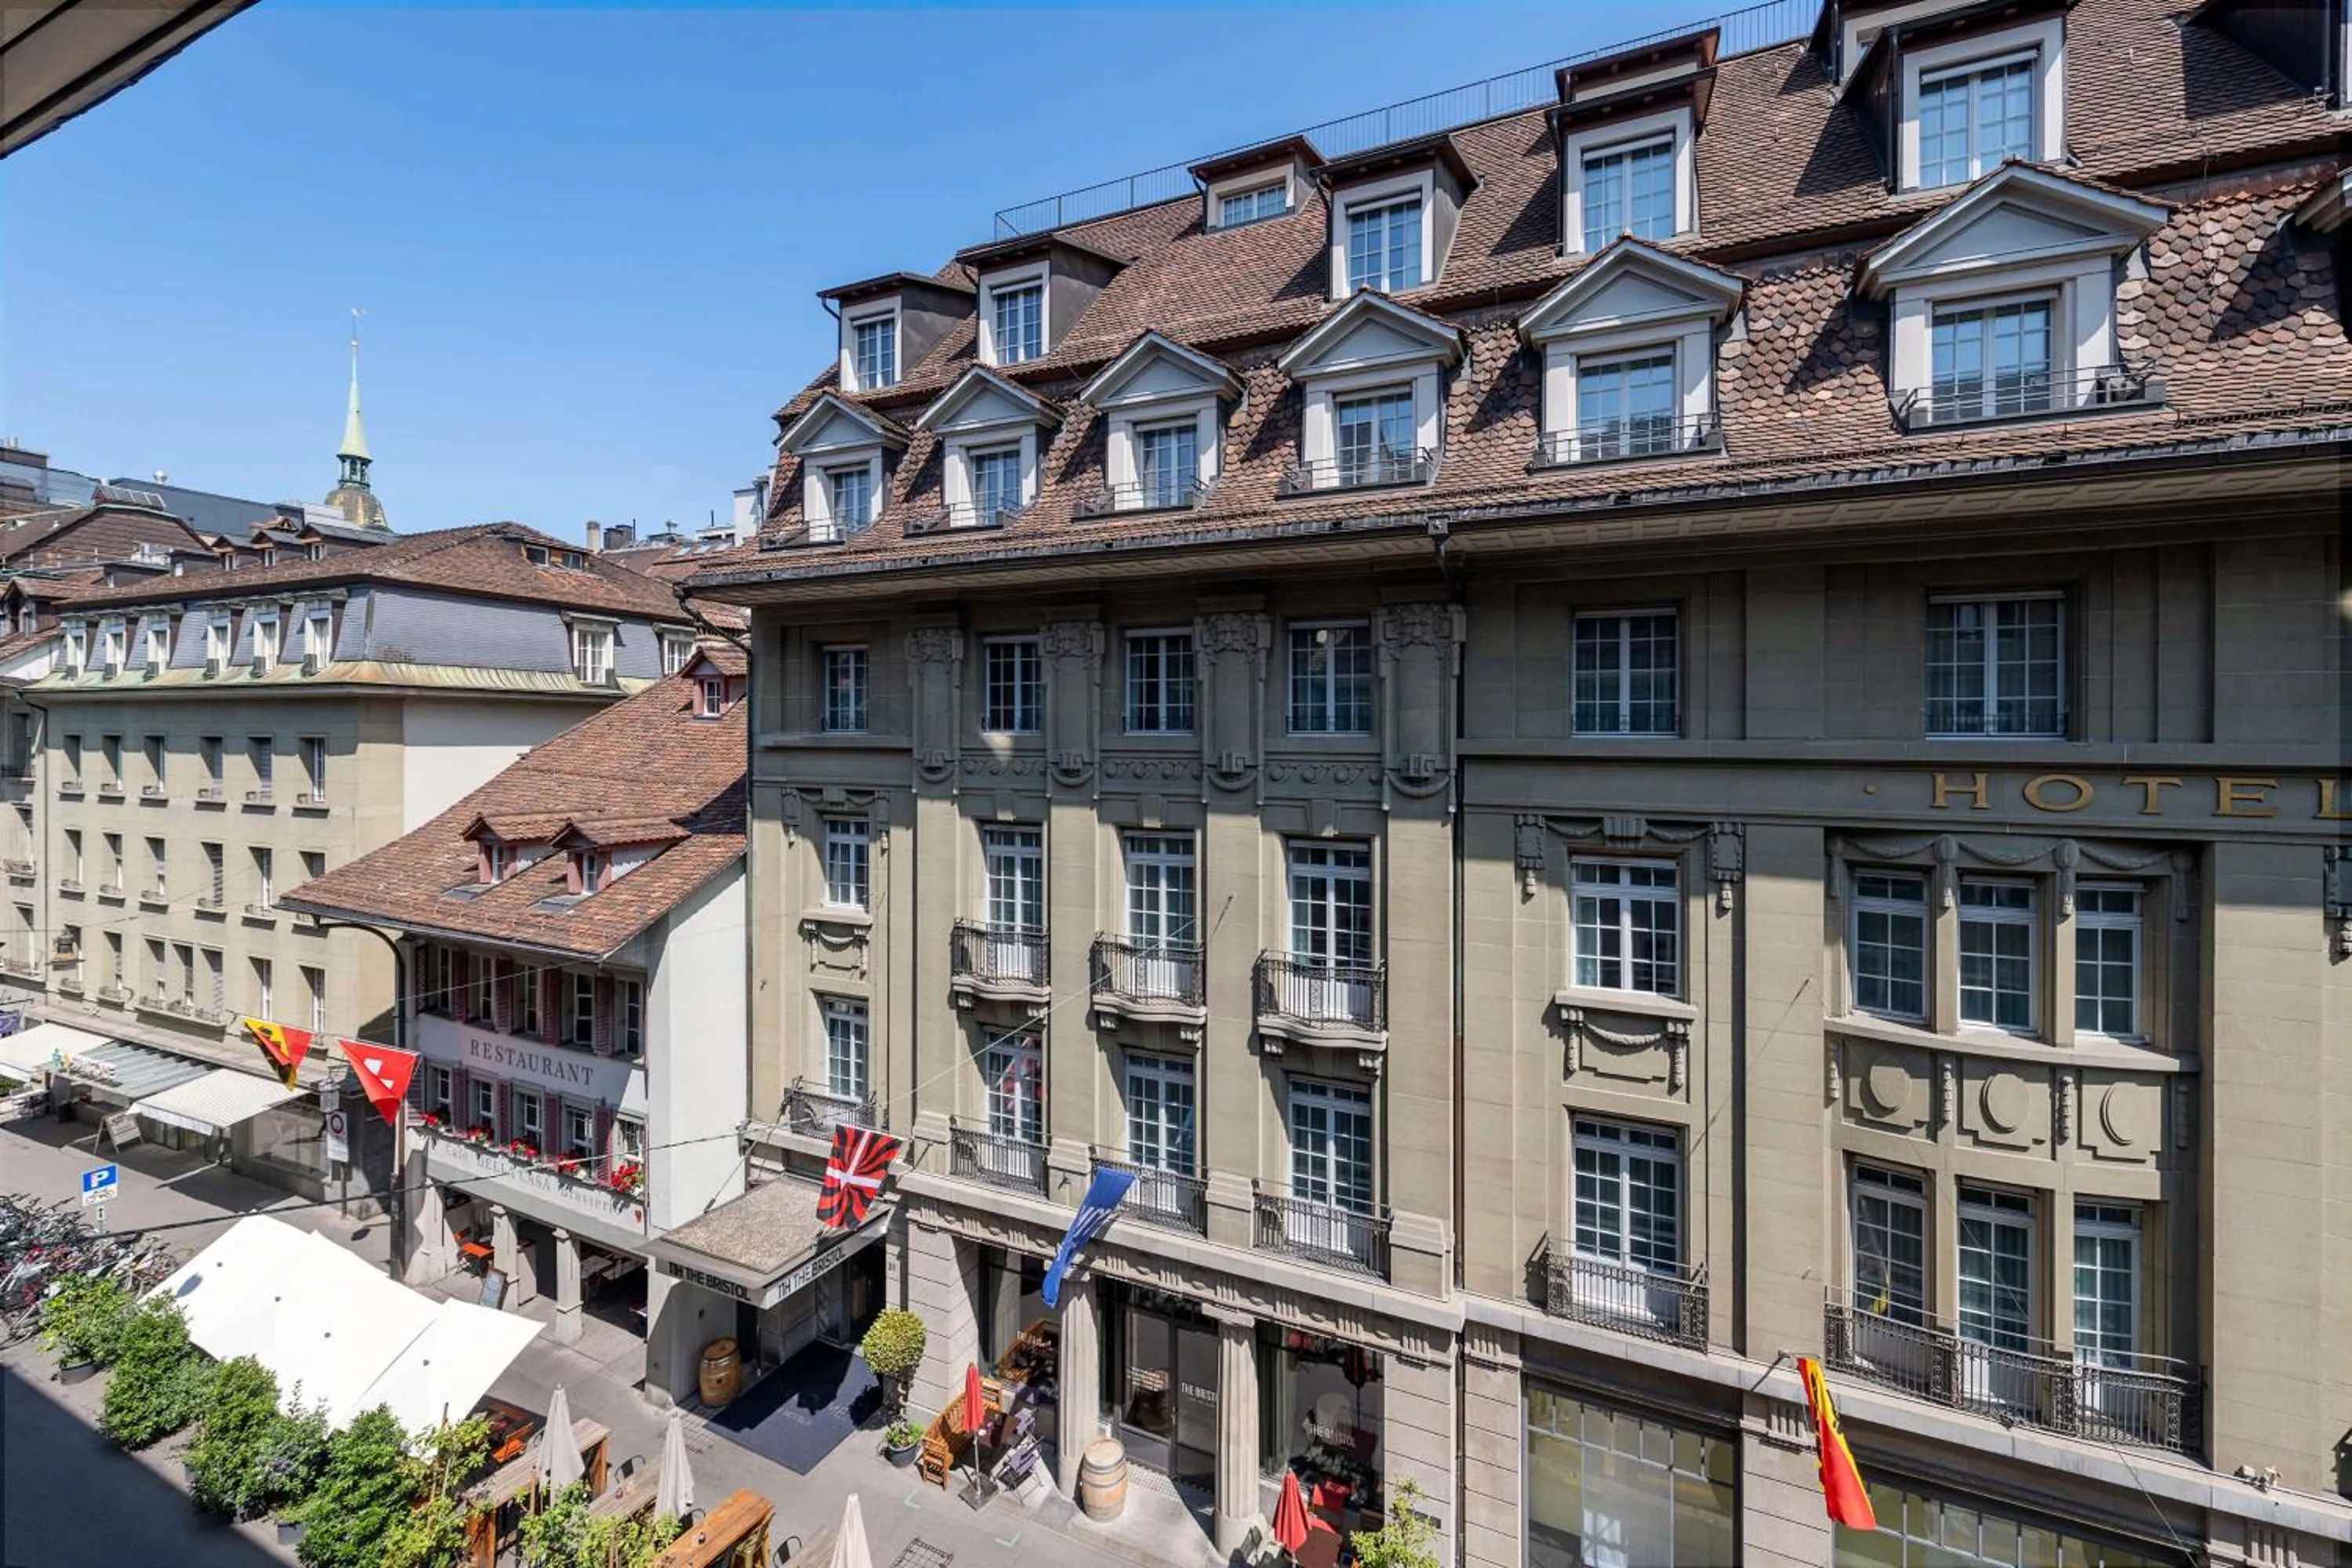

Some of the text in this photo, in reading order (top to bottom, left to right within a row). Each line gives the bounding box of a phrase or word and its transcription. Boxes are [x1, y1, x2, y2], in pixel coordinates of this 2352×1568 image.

[1929, 771, 2352, 820] HOTEL
[470, 1039, 594, 1086] RESTAURANT
[90, 1170, 110, 1189] P
[812, 1245, 846, 1278] BRISTOL
[684, 1266, 705, 1287] THE
[706, 1273, 751, 1302] BRISTOL
[1195, 1385, 1217, 1403] BRIST
